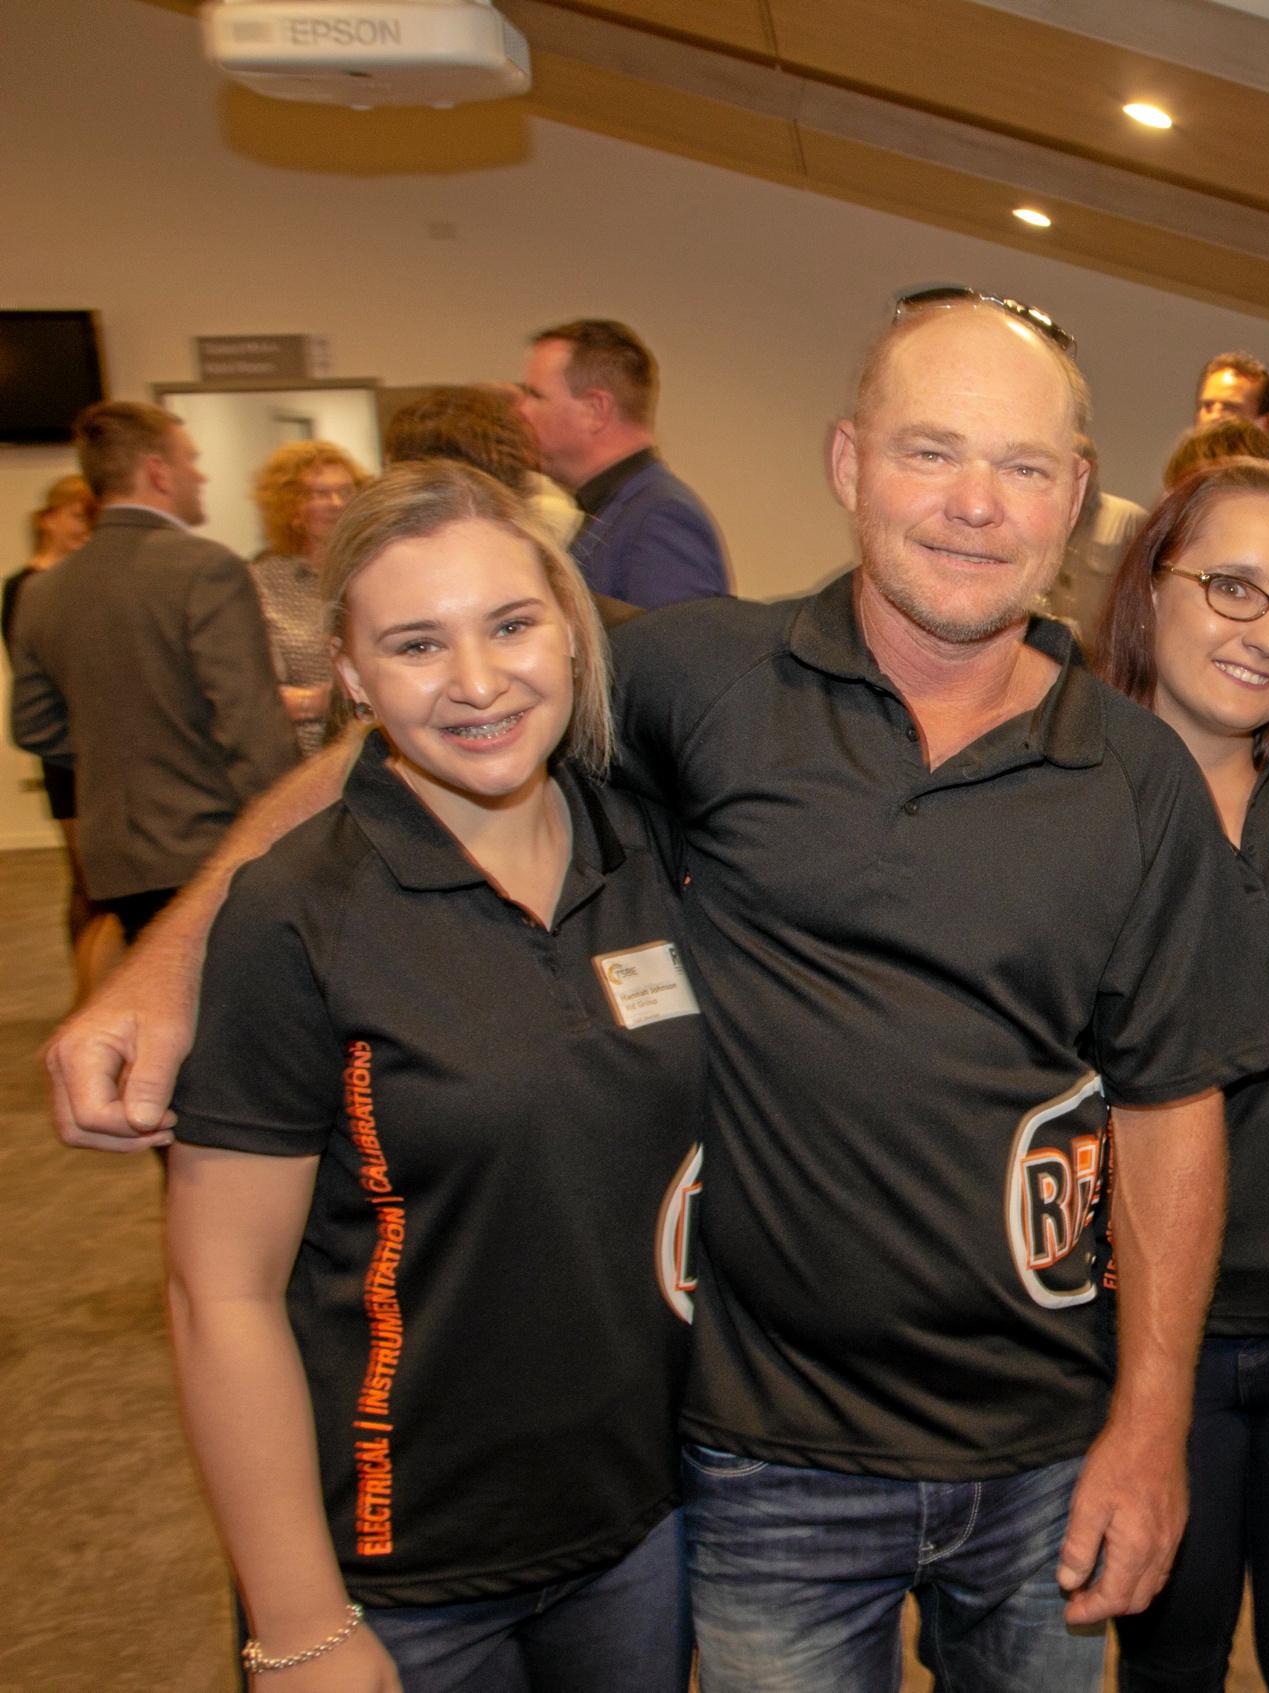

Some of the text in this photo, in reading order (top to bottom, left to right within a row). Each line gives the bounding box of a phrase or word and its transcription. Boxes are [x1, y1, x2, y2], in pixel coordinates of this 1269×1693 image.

[290, 18, 402, 46] EPSON
[344, 1040, 394, 1193] CALIBRATIONS
[358, 1207, 406, 1415] INSTRUMENTATION
[356, 1438, 393, 1555] ELECTRICAL
